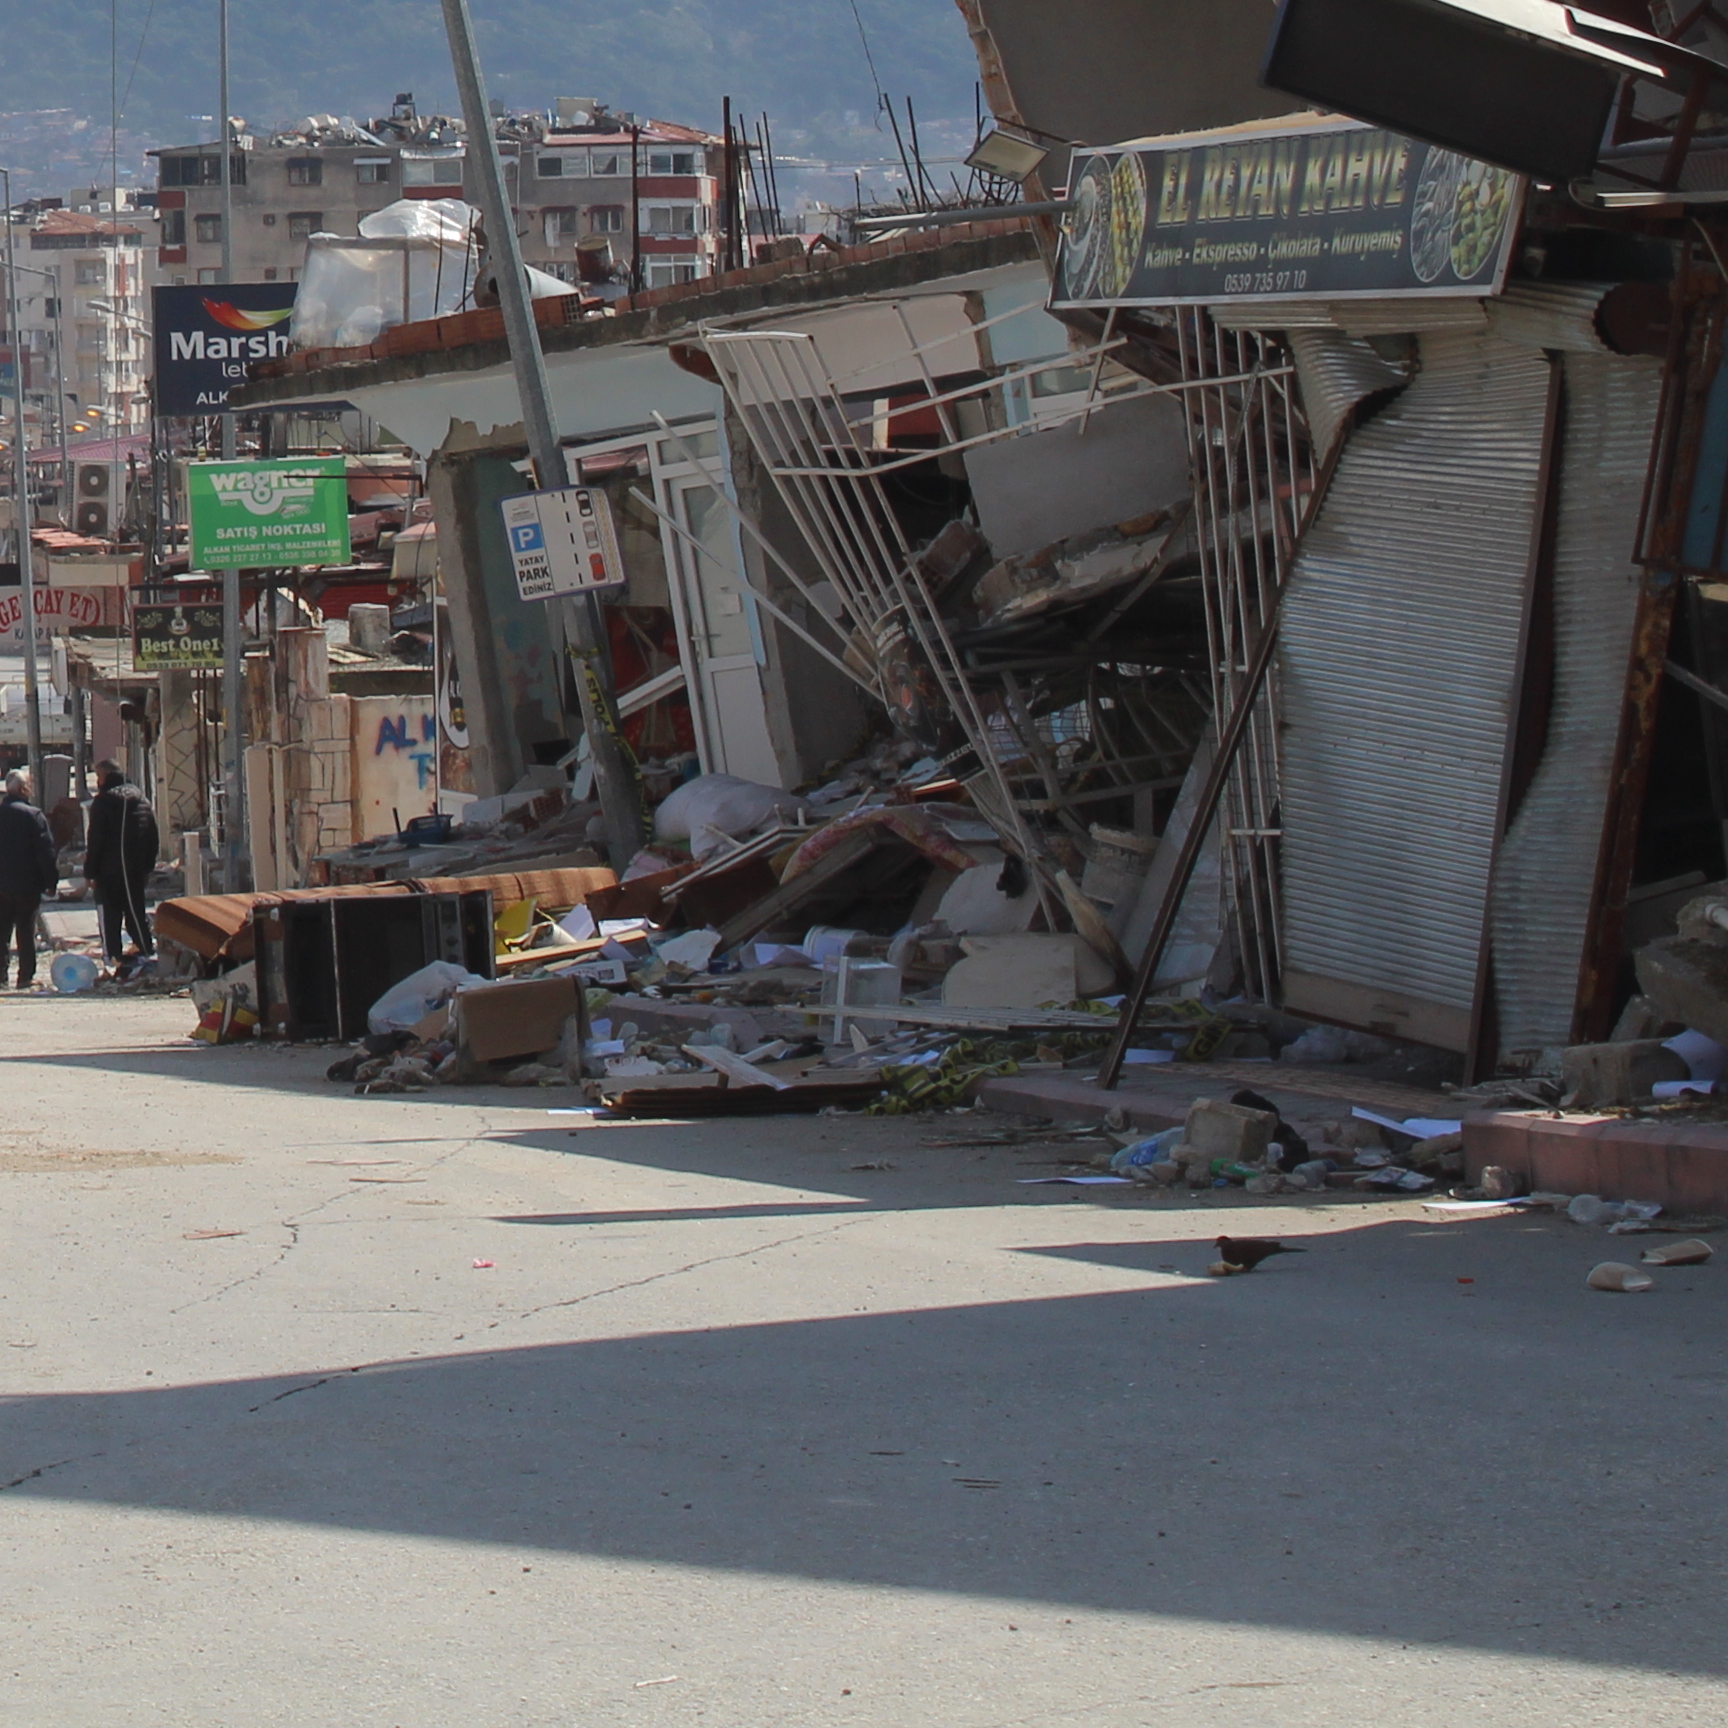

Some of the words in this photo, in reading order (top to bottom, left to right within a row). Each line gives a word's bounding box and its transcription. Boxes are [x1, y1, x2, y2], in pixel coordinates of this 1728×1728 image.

[1156, 148, 1192, 228] EL
[1196, 136, 1301, 223] REYAN
[1298, 129, 1410, 217] KAHVE
[1144, 240, 1182, 269] Kahve
[1193, 236, 1258, 270] Ekspresso
[1268, 231, 1320, 268] Çikolata
[1331, 228, 1403, 261] Kuruyemiş
[1224, 272, 1250, 293] 0539
[1254, 272, 1274, 292] 735
[1276, 271, 1291, 290] 97
[1293, 270, 1307, 289] 10
[170, 331, 289, 360] Marsh
[196, 391, 228, 405] ALK
[209, 468, 321, 502] wagner
[216, 526, 258, 539] SATIŞ
[262, 523, 326, 536] NOKTASI
[518, 528, 534, 548] P
[518, 555, 545, 567] YATAY
[519, 566, 550, 582] PARK
[523, 582, 554, 596] EDİNİZ
[141, 638, 175, 653] Best
